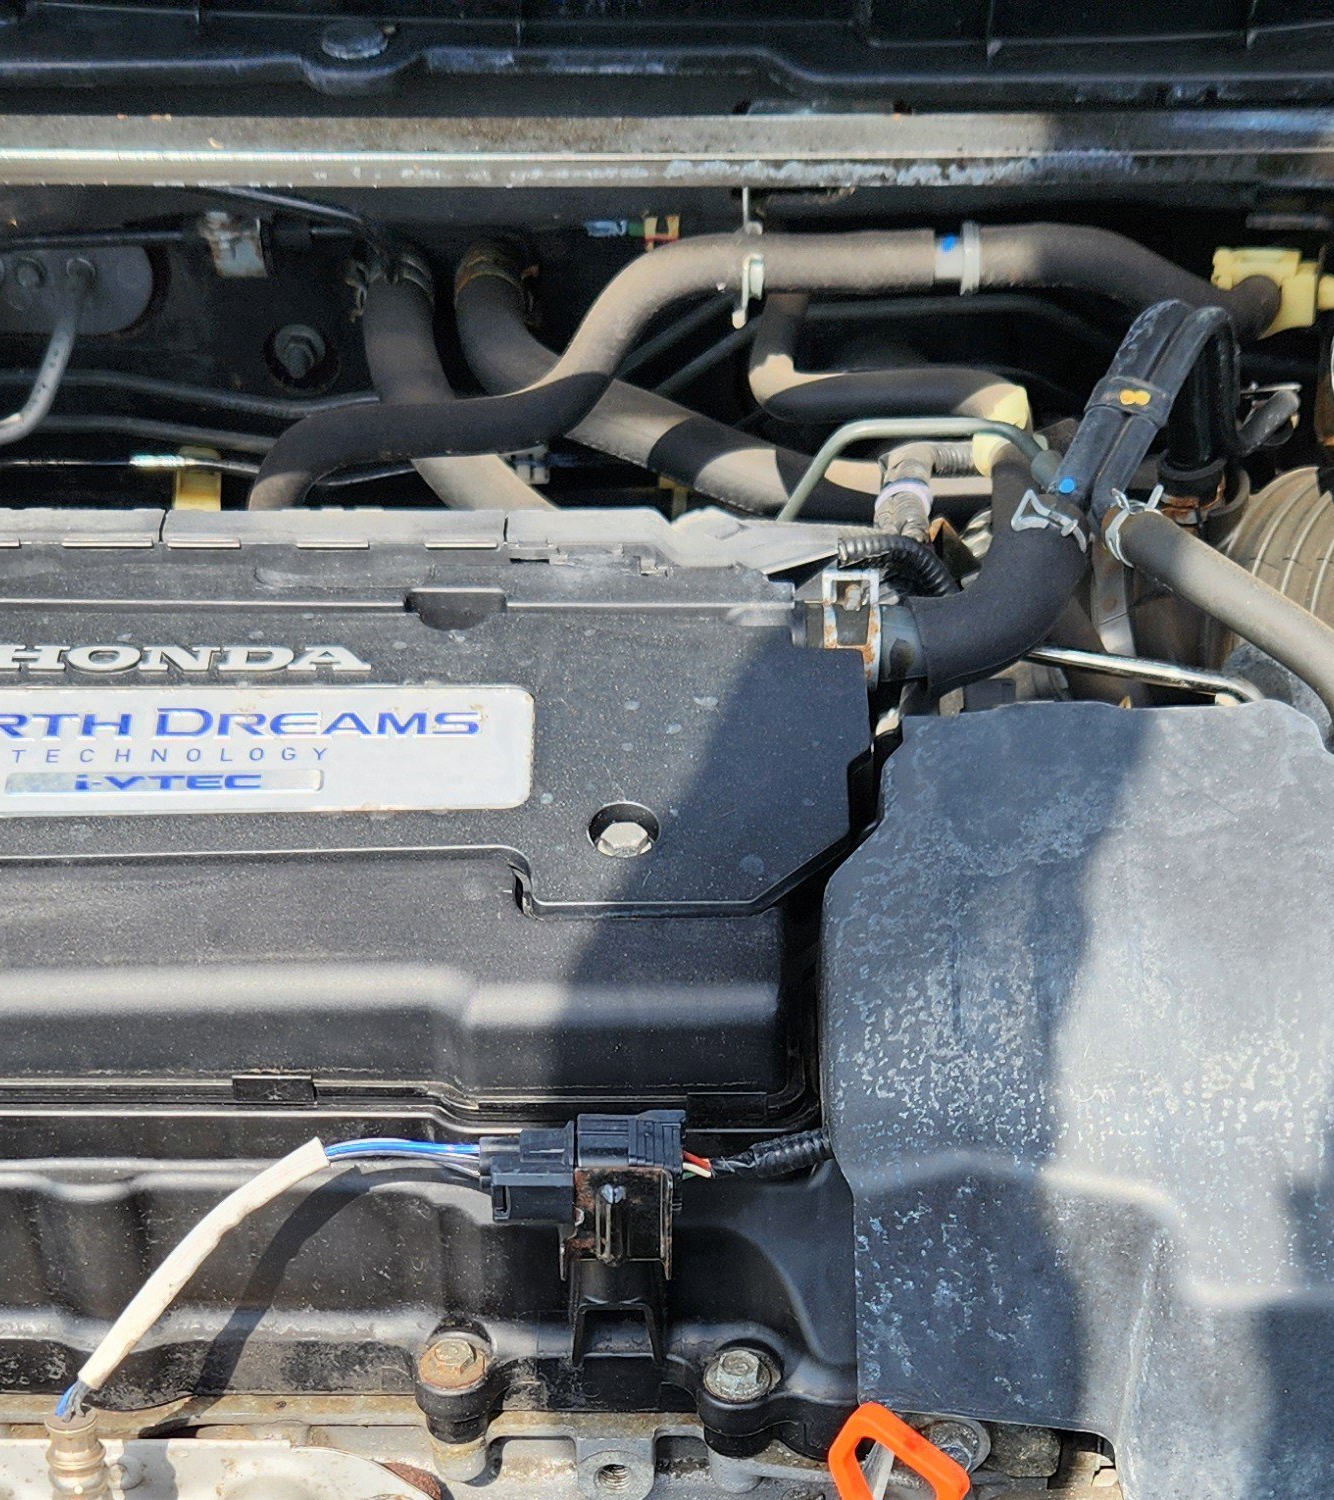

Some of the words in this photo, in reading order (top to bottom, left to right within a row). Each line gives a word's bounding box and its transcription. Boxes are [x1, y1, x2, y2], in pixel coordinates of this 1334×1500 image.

[156, 706, 483, 737] DREAMS
[12, 746, 331, 764] TECHNOLOGY
[75, 773, 263, 792] i-VTEC
